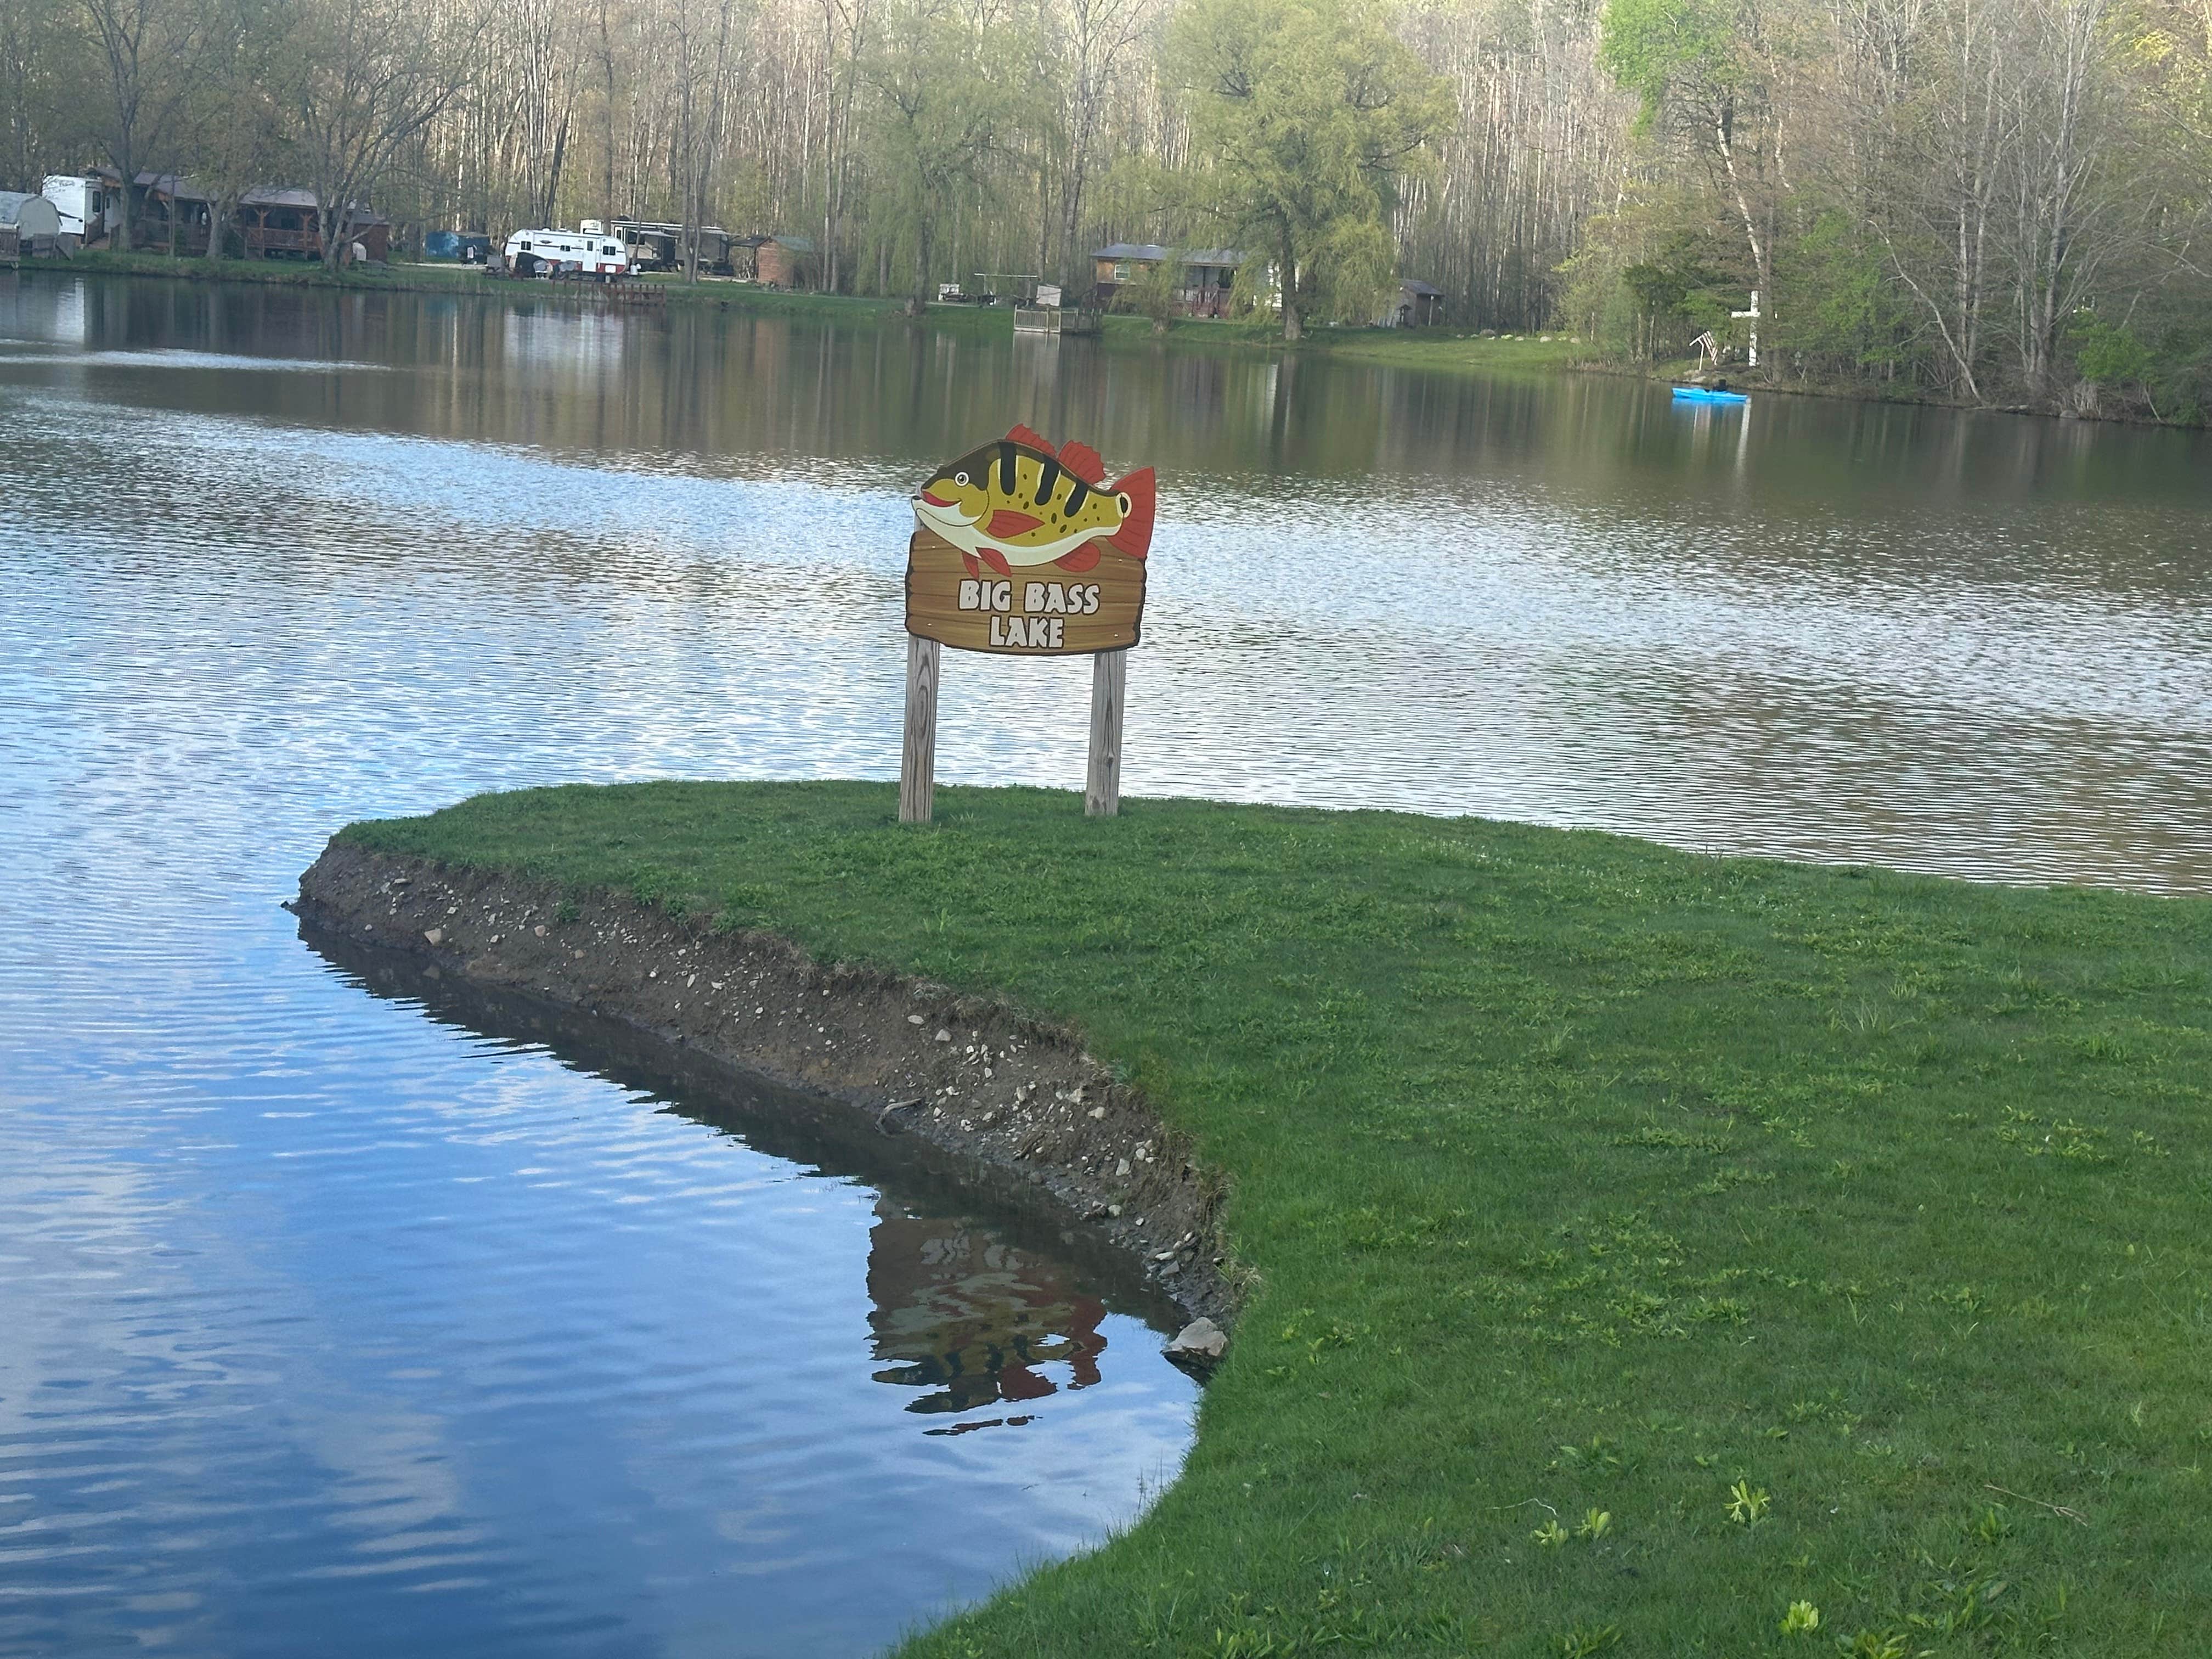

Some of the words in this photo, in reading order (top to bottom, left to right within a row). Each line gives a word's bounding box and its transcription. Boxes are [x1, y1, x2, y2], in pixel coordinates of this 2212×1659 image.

[959, 579, 1012, 612] BIG
[1024, 582, 1100, 615] BASS
[989, 616, 1064, 649] LAKE
